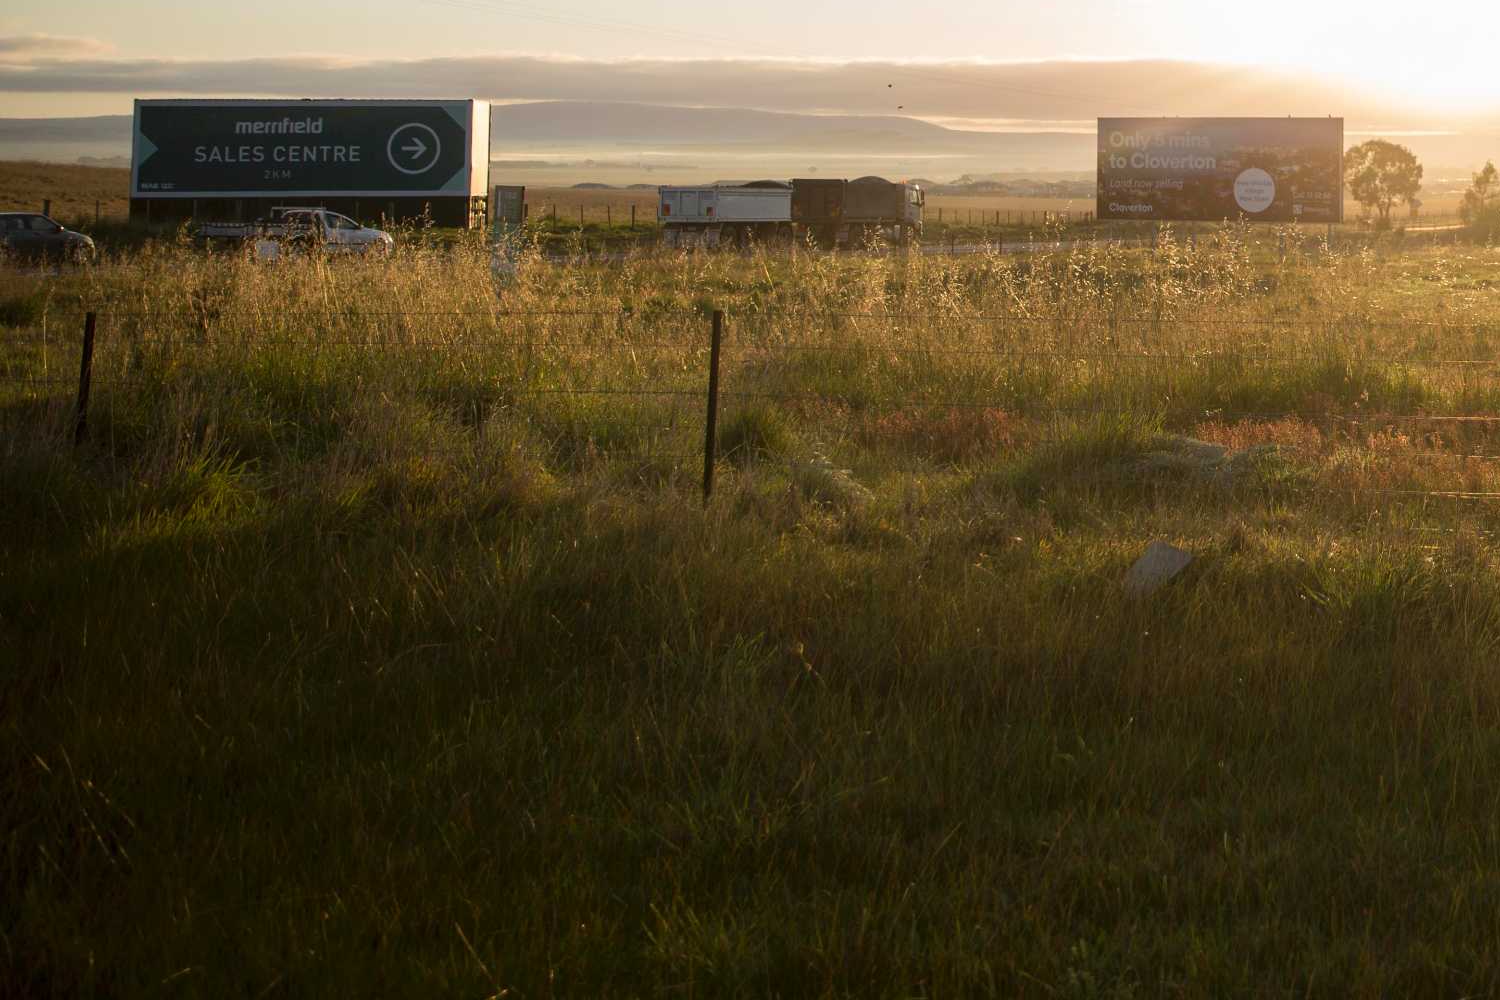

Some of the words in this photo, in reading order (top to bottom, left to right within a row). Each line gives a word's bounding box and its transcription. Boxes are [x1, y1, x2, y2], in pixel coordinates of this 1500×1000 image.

[234, 117, 324, 135] merrifield
[1109, 130, 1151, 150] Only
[1168, 130, 1210, 148] mins
[194, 146, 265, 162] SALES
[273, 146, 361, 162] CENTRE
[1108, 154, 1127, 169] to
[1130, 152, 1217, 169] Cloverton
[1108, 201, 1153, 213] Cloverton
